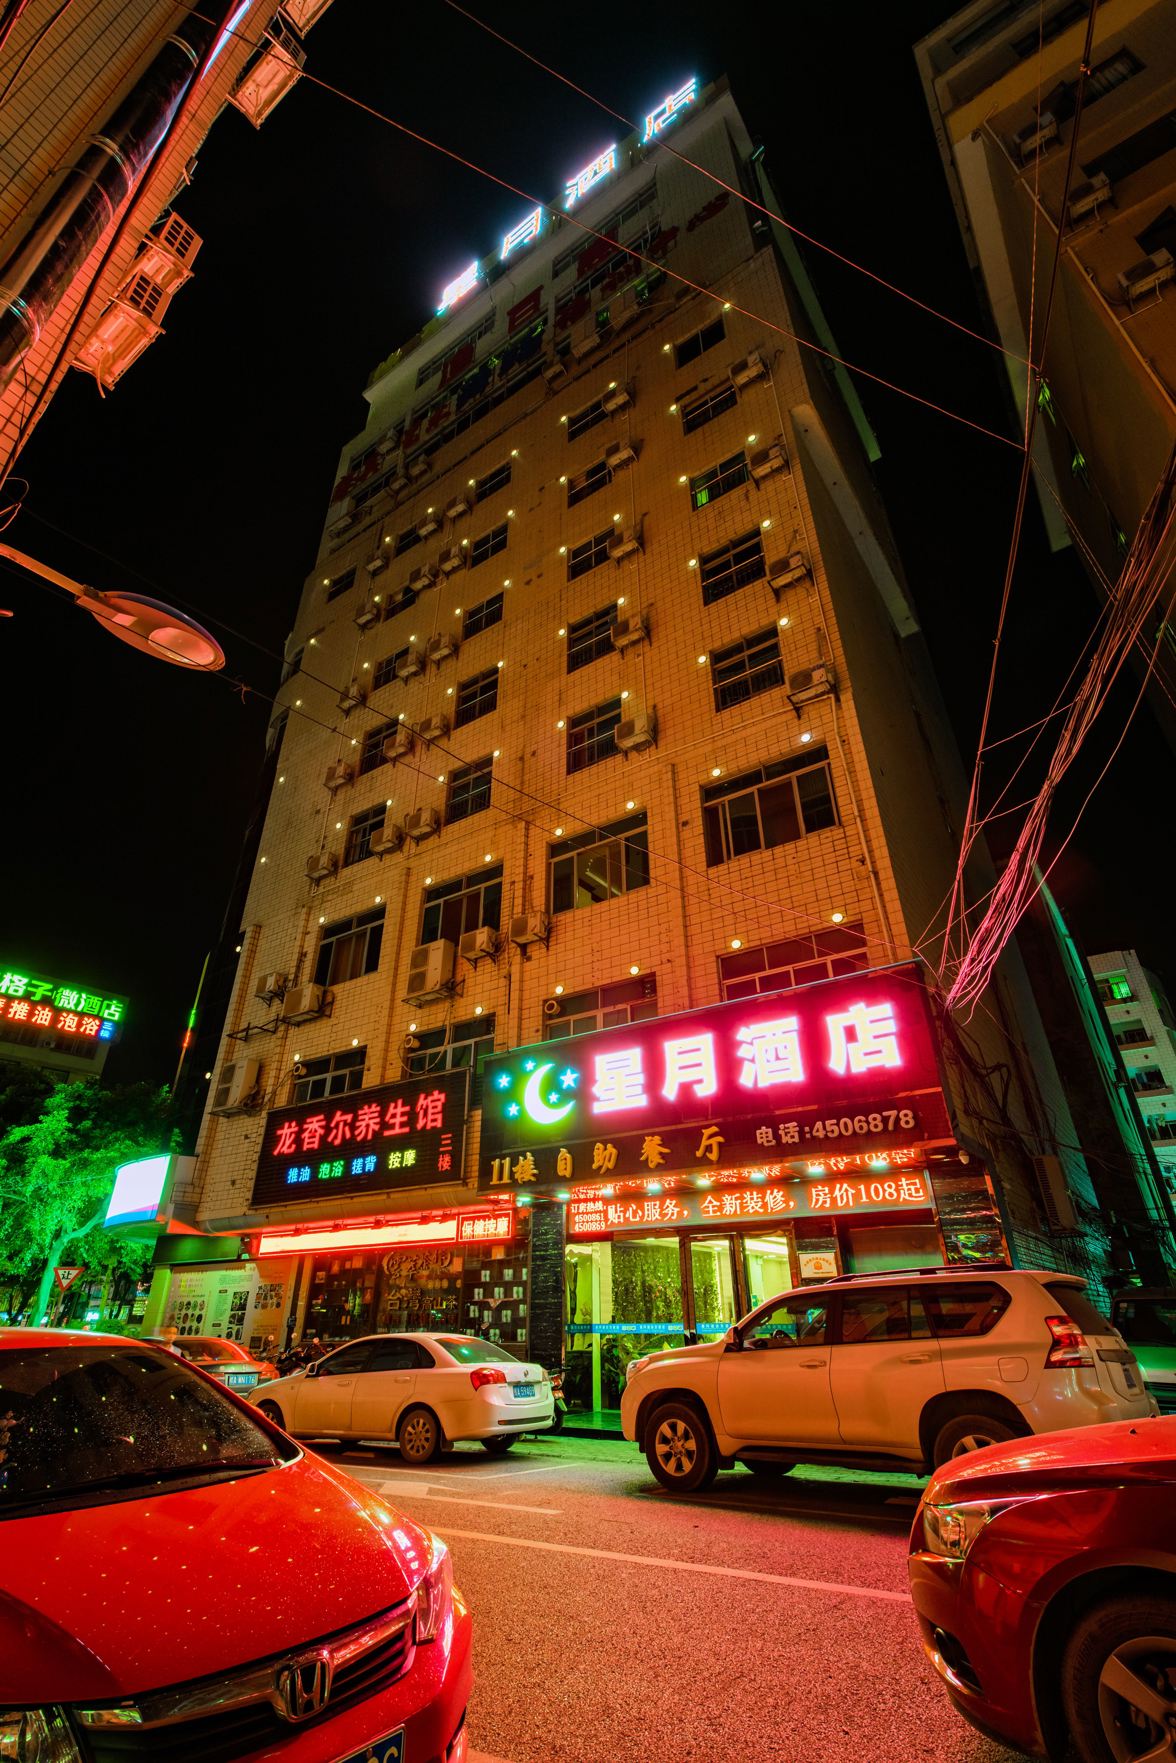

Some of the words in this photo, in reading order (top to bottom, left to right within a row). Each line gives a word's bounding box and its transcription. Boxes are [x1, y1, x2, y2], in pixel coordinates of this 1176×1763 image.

[592, 1002, 904, 1115] 星月酒店
[273, 1089, 447, 1156] 龙香尔养生馆
[317, 1160, 345, 1180] 泡浴
[388, 1149, 417, 1169] 按摩
[437, 1133, 453, 1172] 三楼
[61, 1270, 72, 1280] 让
